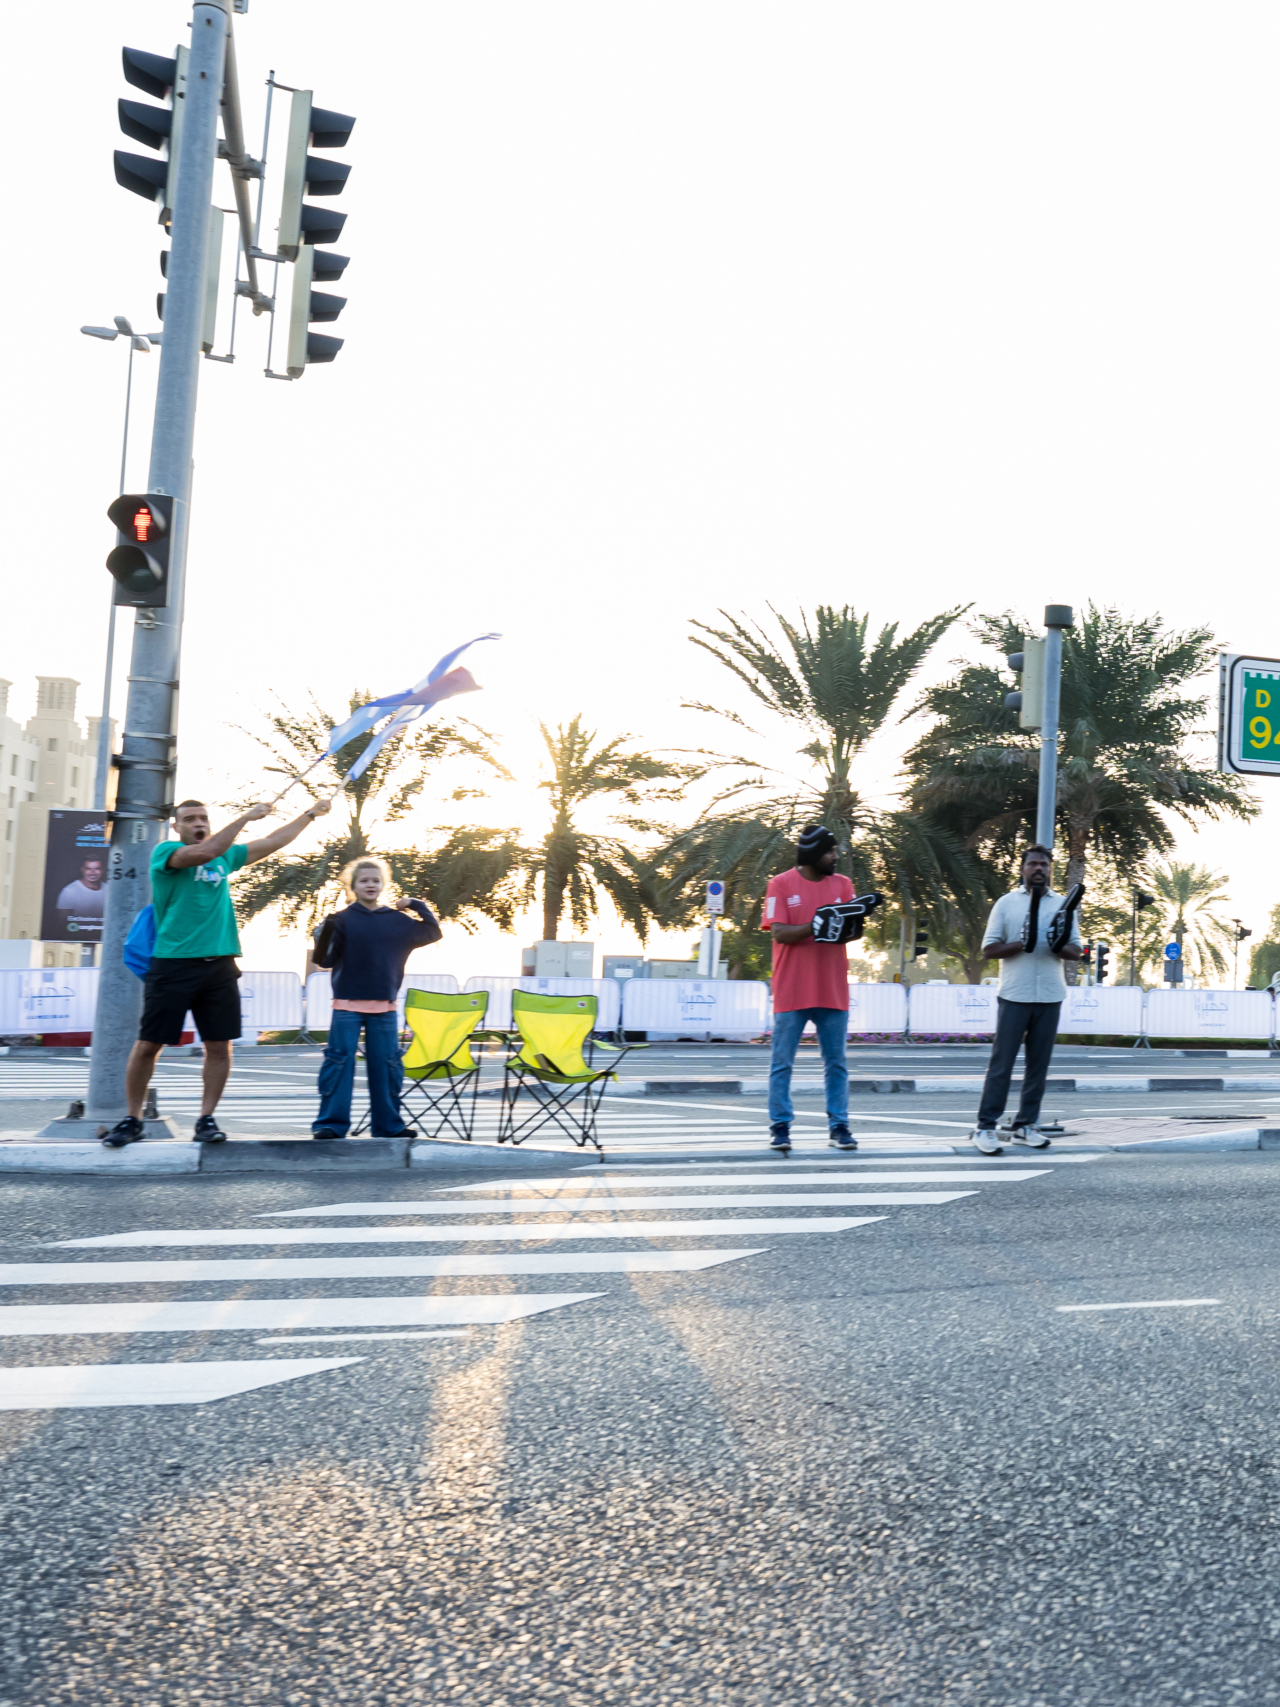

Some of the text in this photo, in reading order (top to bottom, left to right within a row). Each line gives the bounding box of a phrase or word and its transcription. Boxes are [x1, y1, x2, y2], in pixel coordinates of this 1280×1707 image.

[1255, 689, 1272, 708] D
[112, 852, 123, 865] 3
[107, 867, 138, 881] 54
